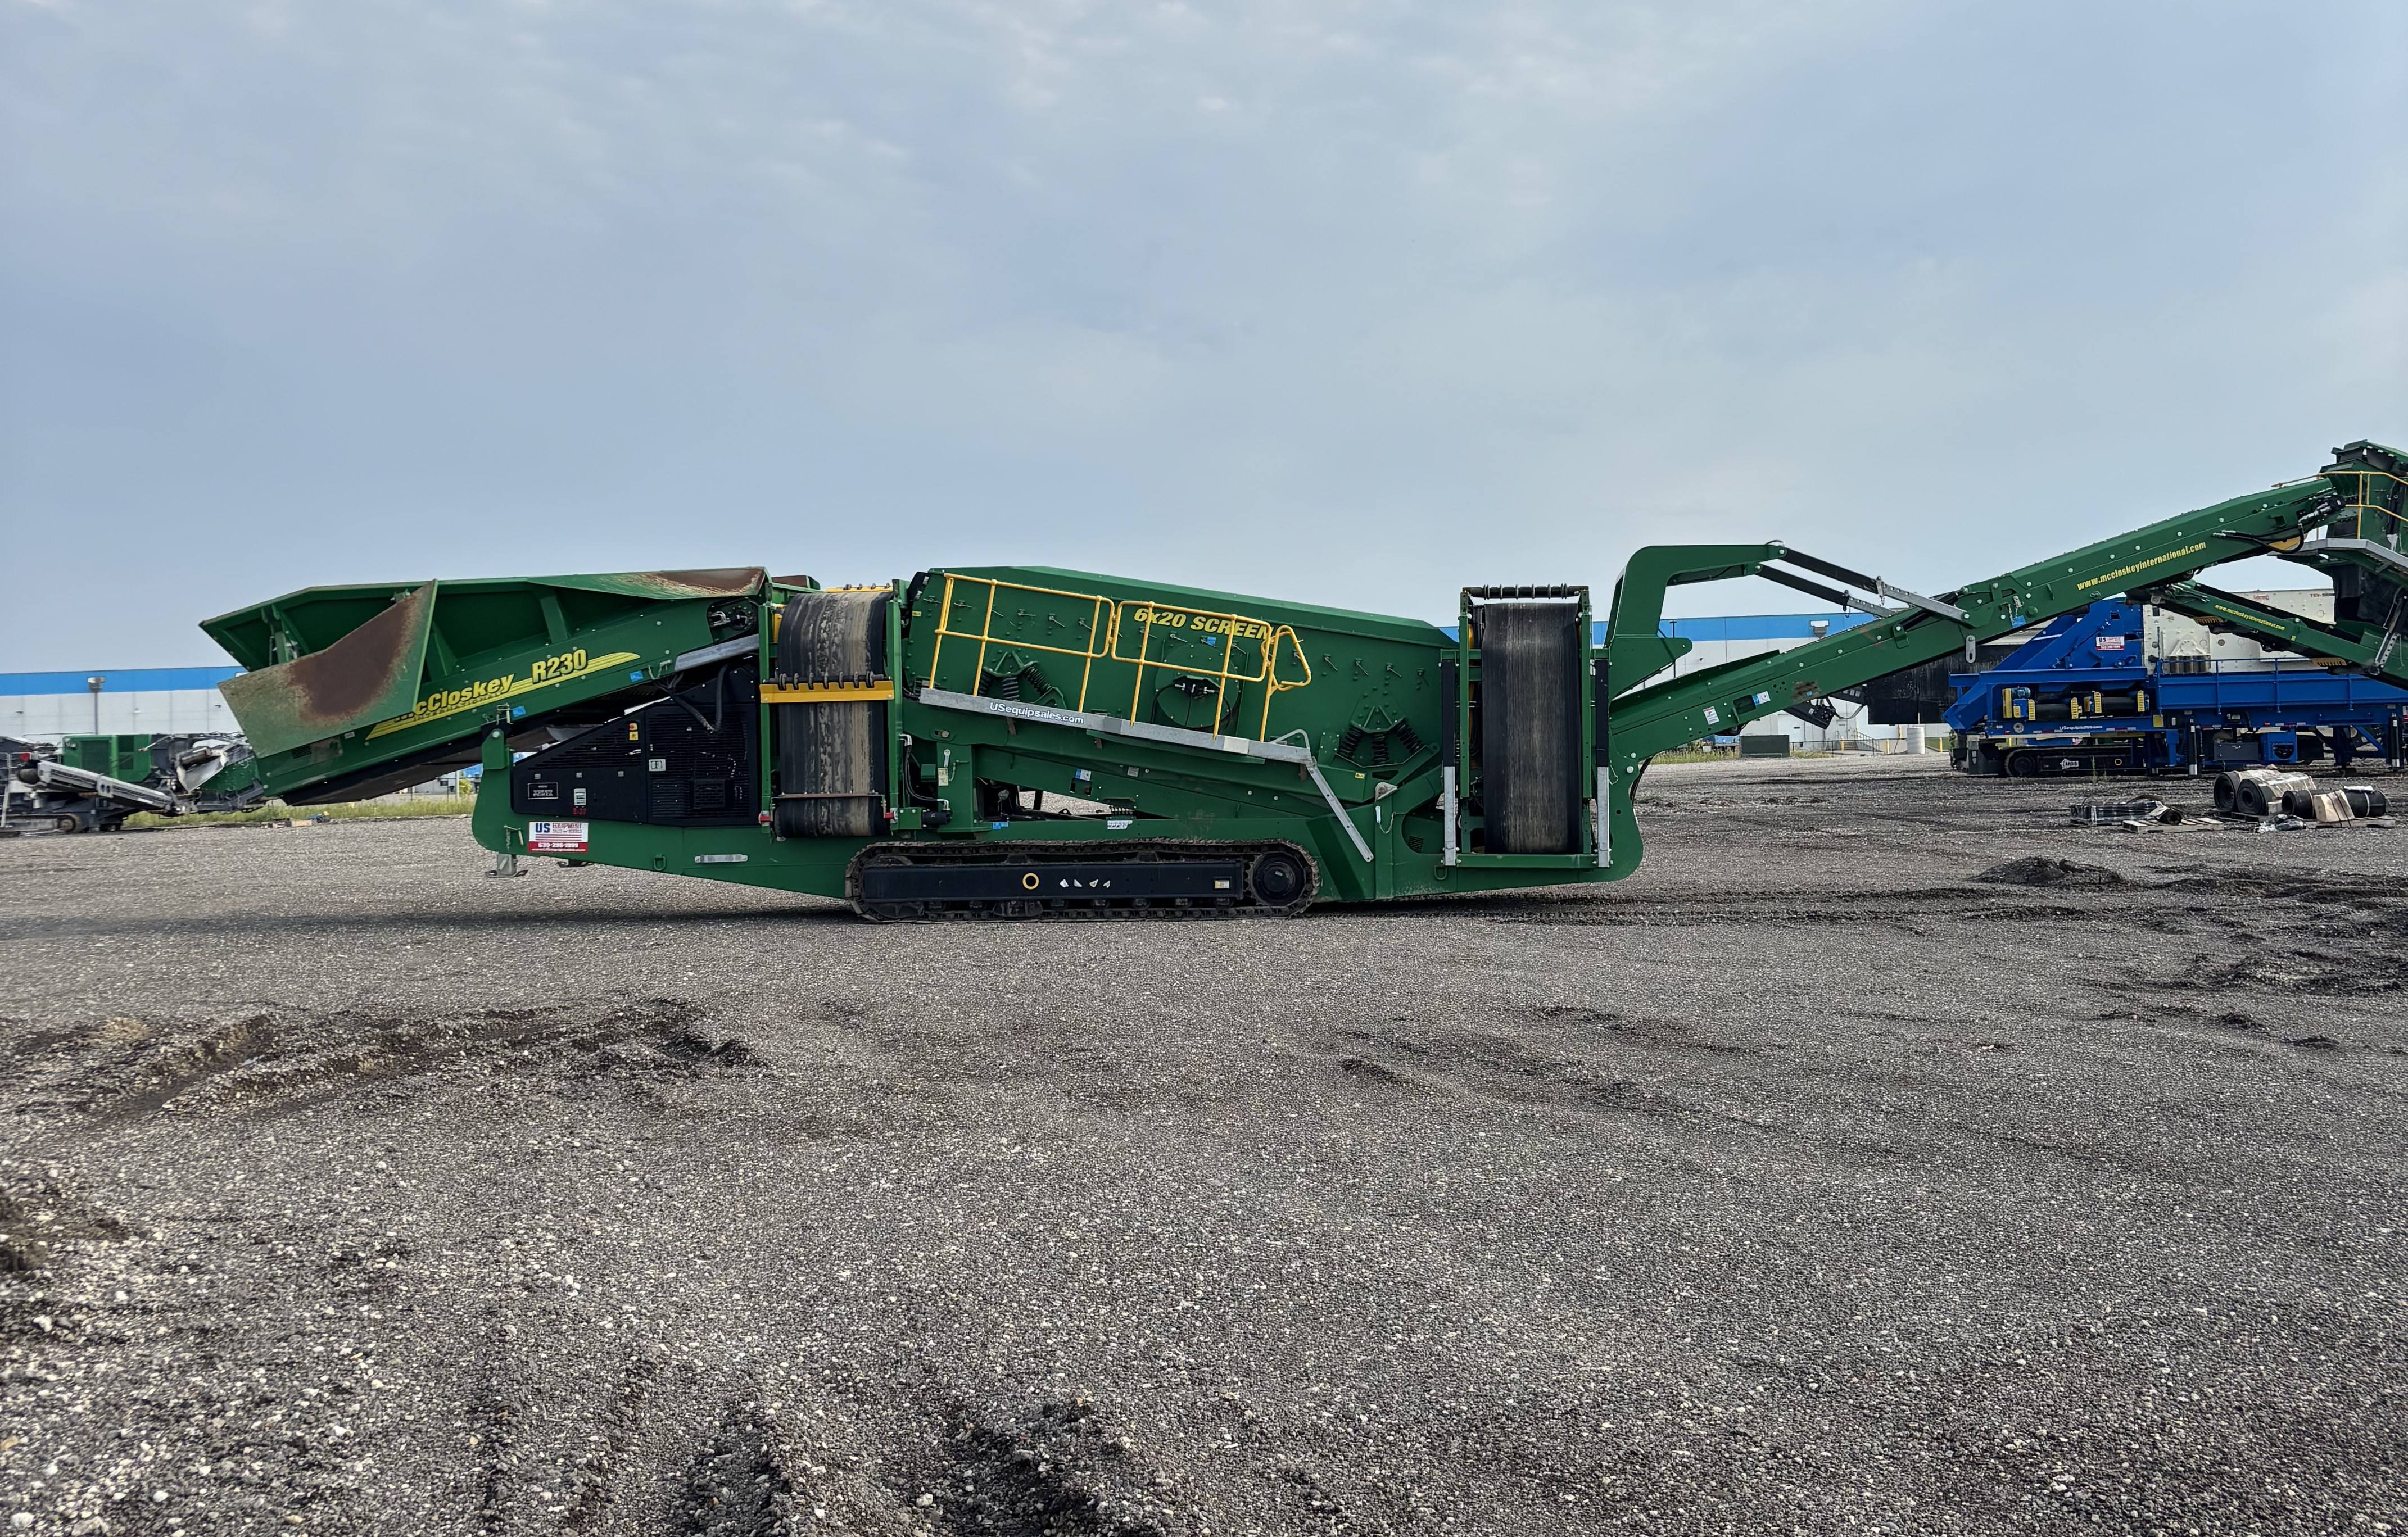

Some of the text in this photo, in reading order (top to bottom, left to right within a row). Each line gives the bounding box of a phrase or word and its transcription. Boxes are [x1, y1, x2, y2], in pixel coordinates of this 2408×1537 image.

[1134, 608, 1187, 628] 6x20
[394, 649, 588, 723] cCloskey R230
[990, 702, 1084, 724] USequipsales.com
[535, 823, 551, 833] US
